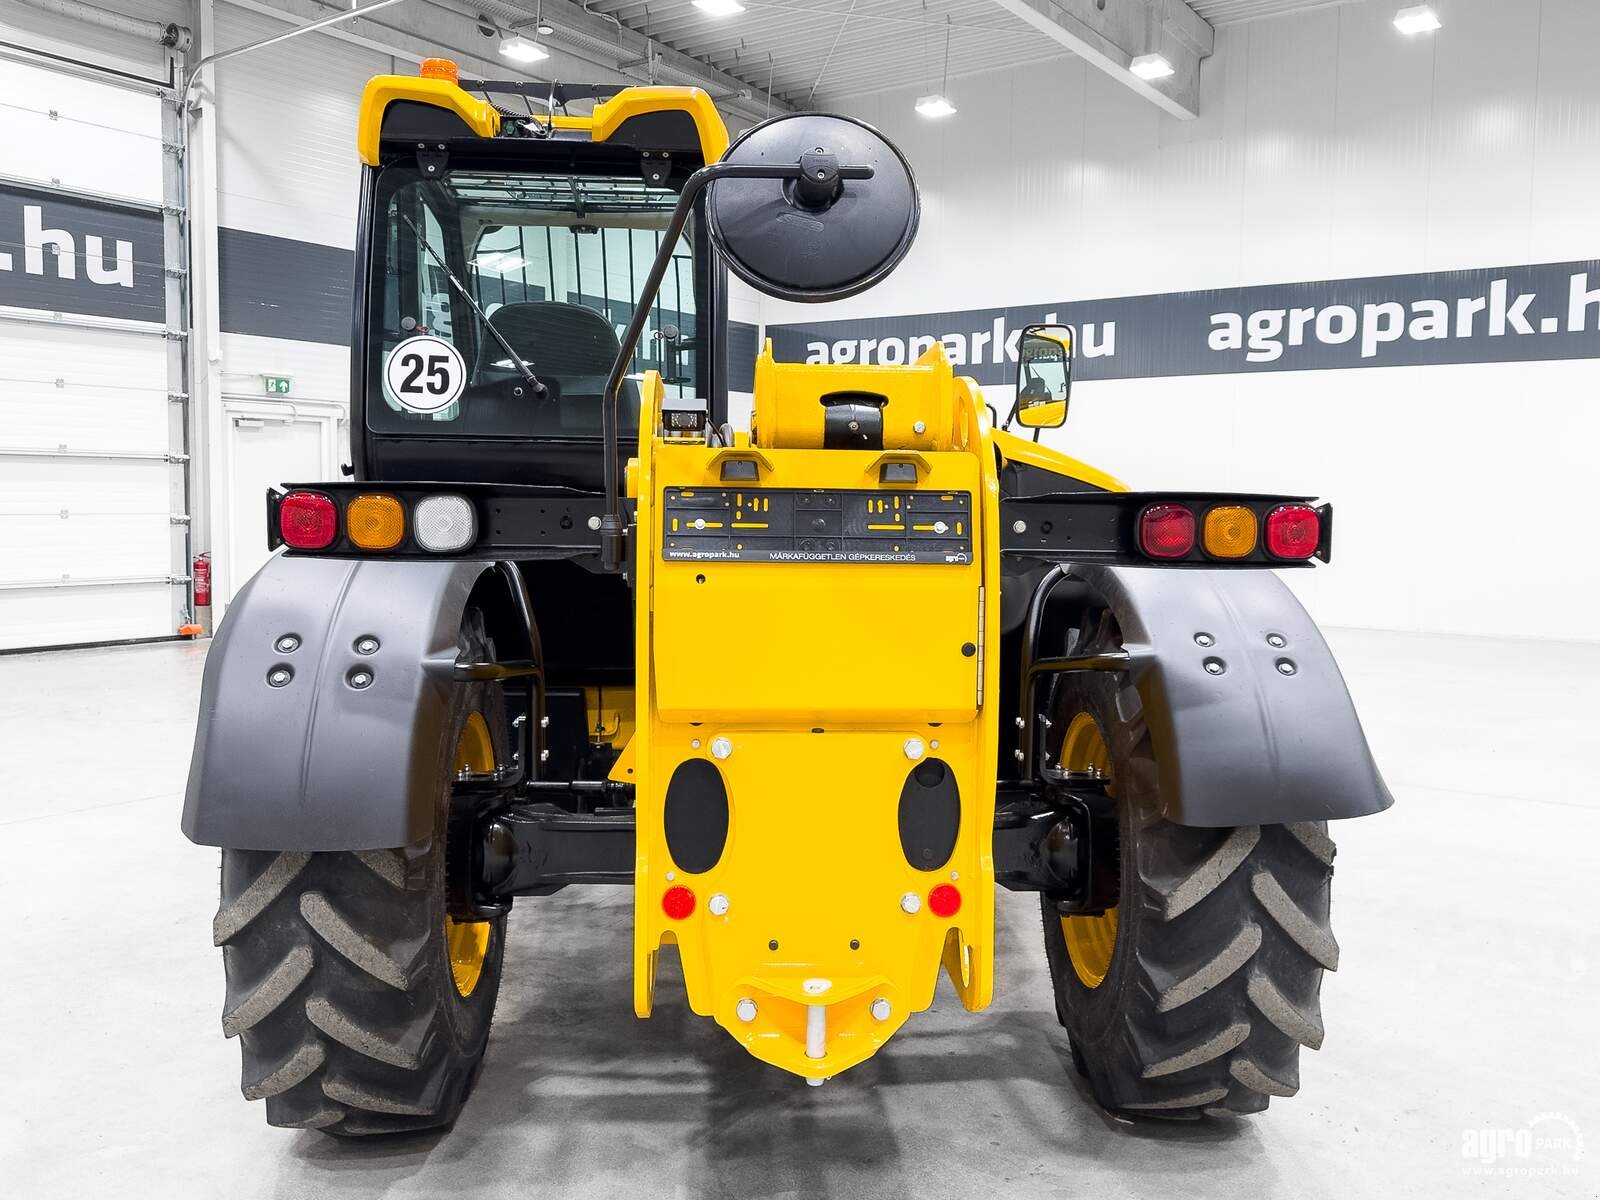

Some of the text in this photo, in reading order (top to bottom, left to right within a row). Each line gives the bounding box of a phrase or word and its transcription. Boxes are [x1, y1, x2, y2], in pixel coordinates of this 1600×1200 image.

[806, 313, 1116, 367] agroarku
[401, 353, 450, 395] 25
[669, 551, 740, 560] www.agropark.hu
